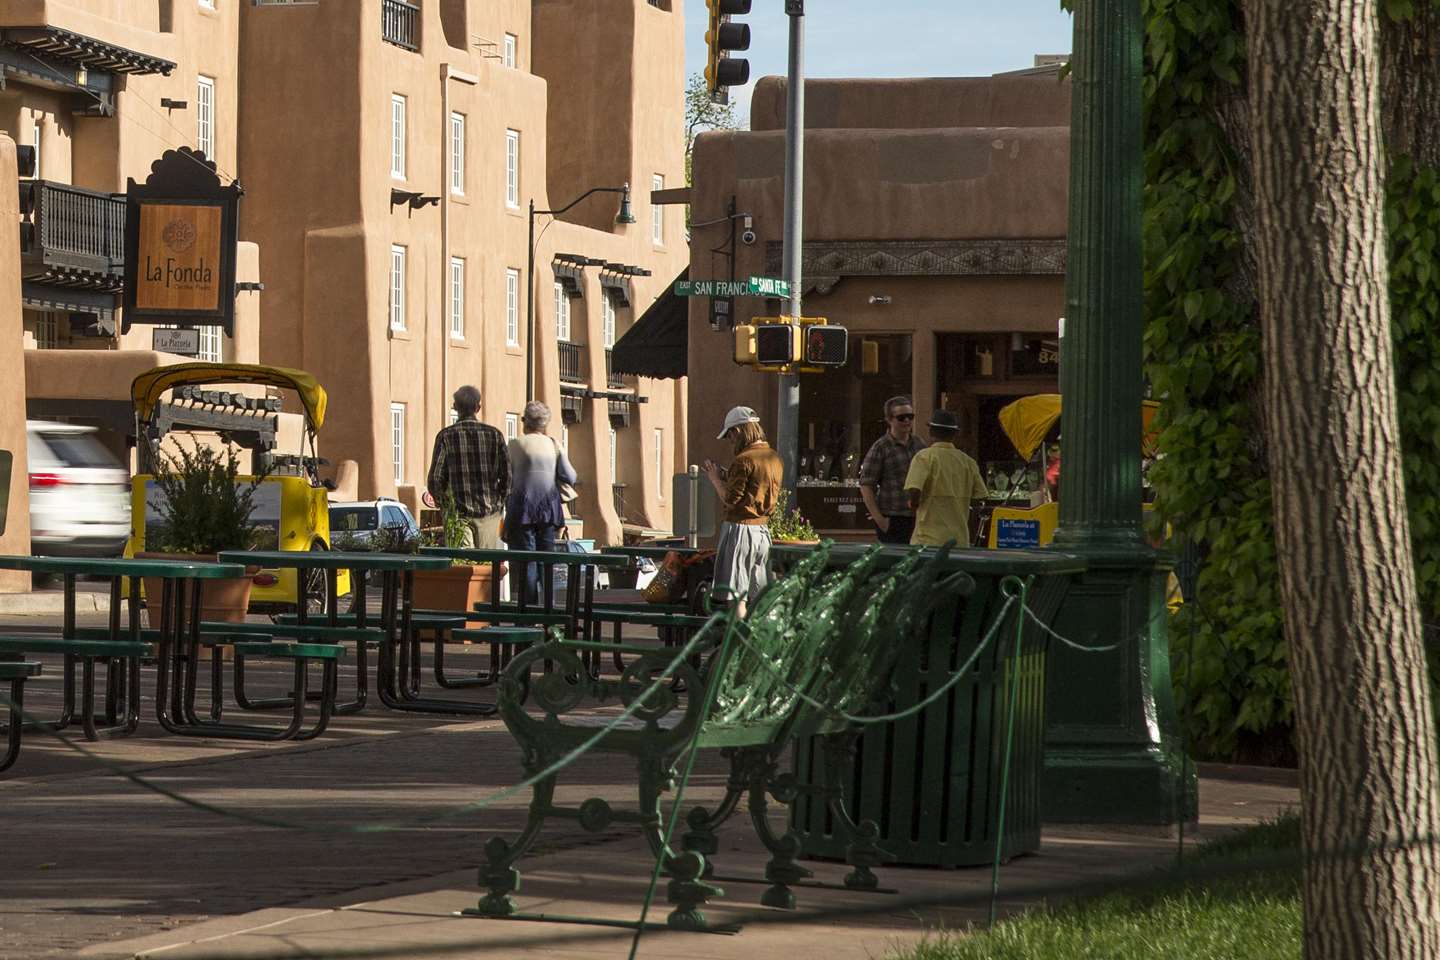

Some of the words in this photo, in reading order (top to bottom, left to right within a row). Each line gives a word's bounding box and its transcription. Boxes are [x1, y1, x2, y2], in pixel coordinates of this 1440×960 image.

[146, 256, 162, 282] La
[166, 257, 212, 288] Fonda
[695, 282, 712, 295] SAN
[716, 282, 764, 296] FRANCI
[758, 278, 774, 294] SANTA
[774, 280, 781, 294] FE
[1039, 351, 1058, 364] 84
